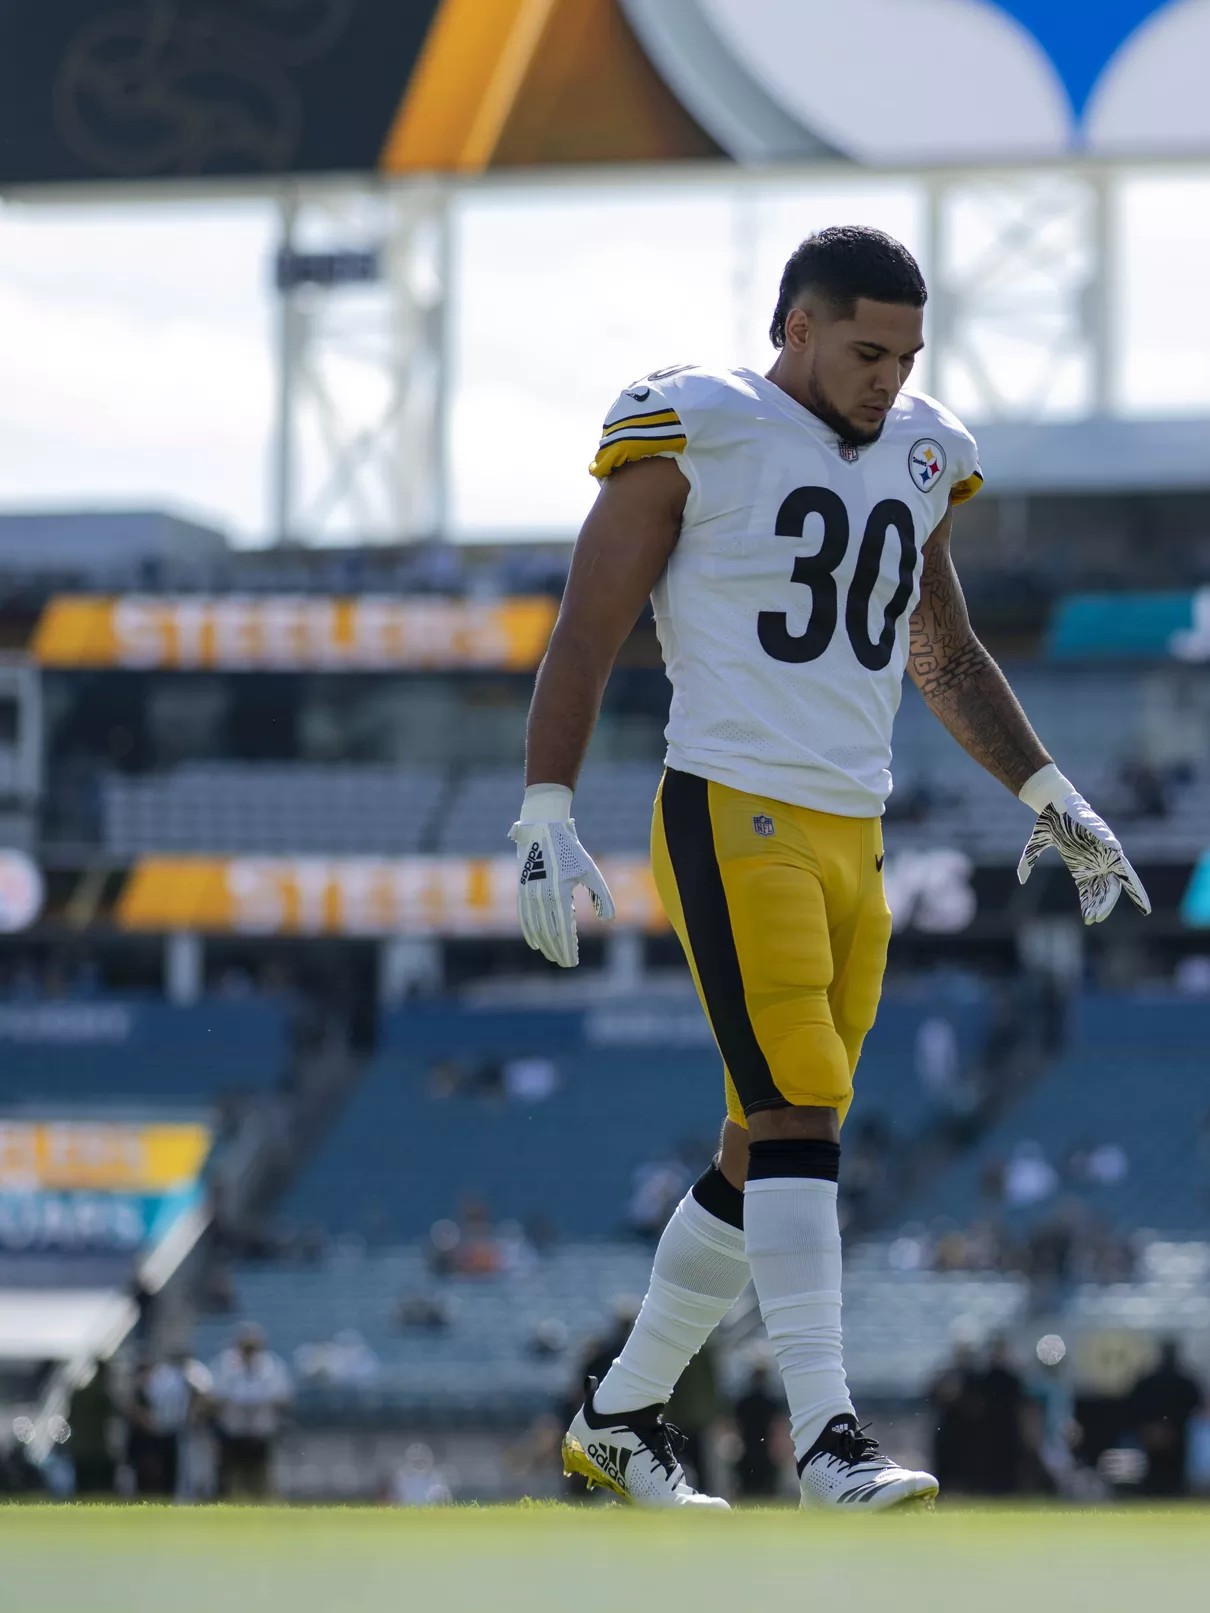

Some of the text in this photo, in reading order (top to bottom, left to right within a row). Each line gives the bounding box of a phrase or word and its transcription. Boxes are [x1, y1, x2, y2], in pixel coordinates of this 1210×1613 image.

[757, 486, 918, 672] 30
[111, 594, 511, 671] STEELERS
[520, 842, 540, 885] adidas
